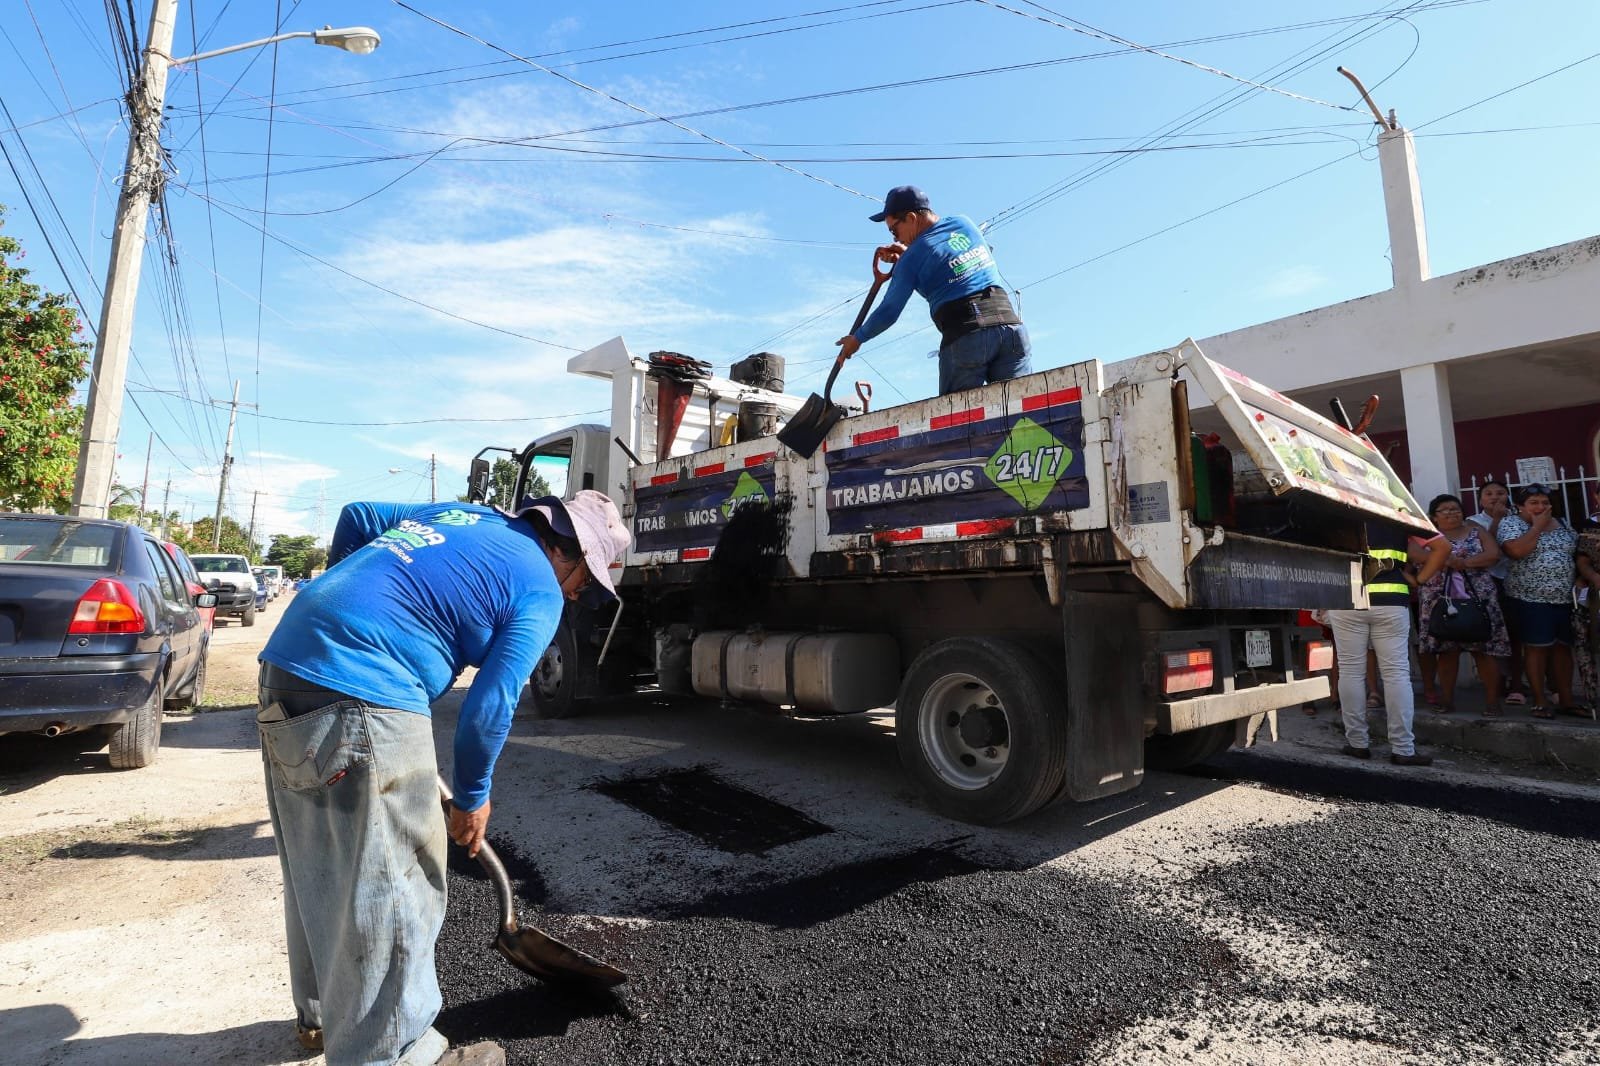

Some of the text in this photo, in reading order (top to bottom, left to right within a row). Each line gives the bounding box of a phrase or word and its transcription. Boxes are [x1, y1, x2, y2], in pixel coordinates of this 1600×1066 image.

[995, 446, 1064, 483] 24/7
[832, 469, 974, 507] TRABAJAMOS
[638, 508, 717, 533] TRABMOS
